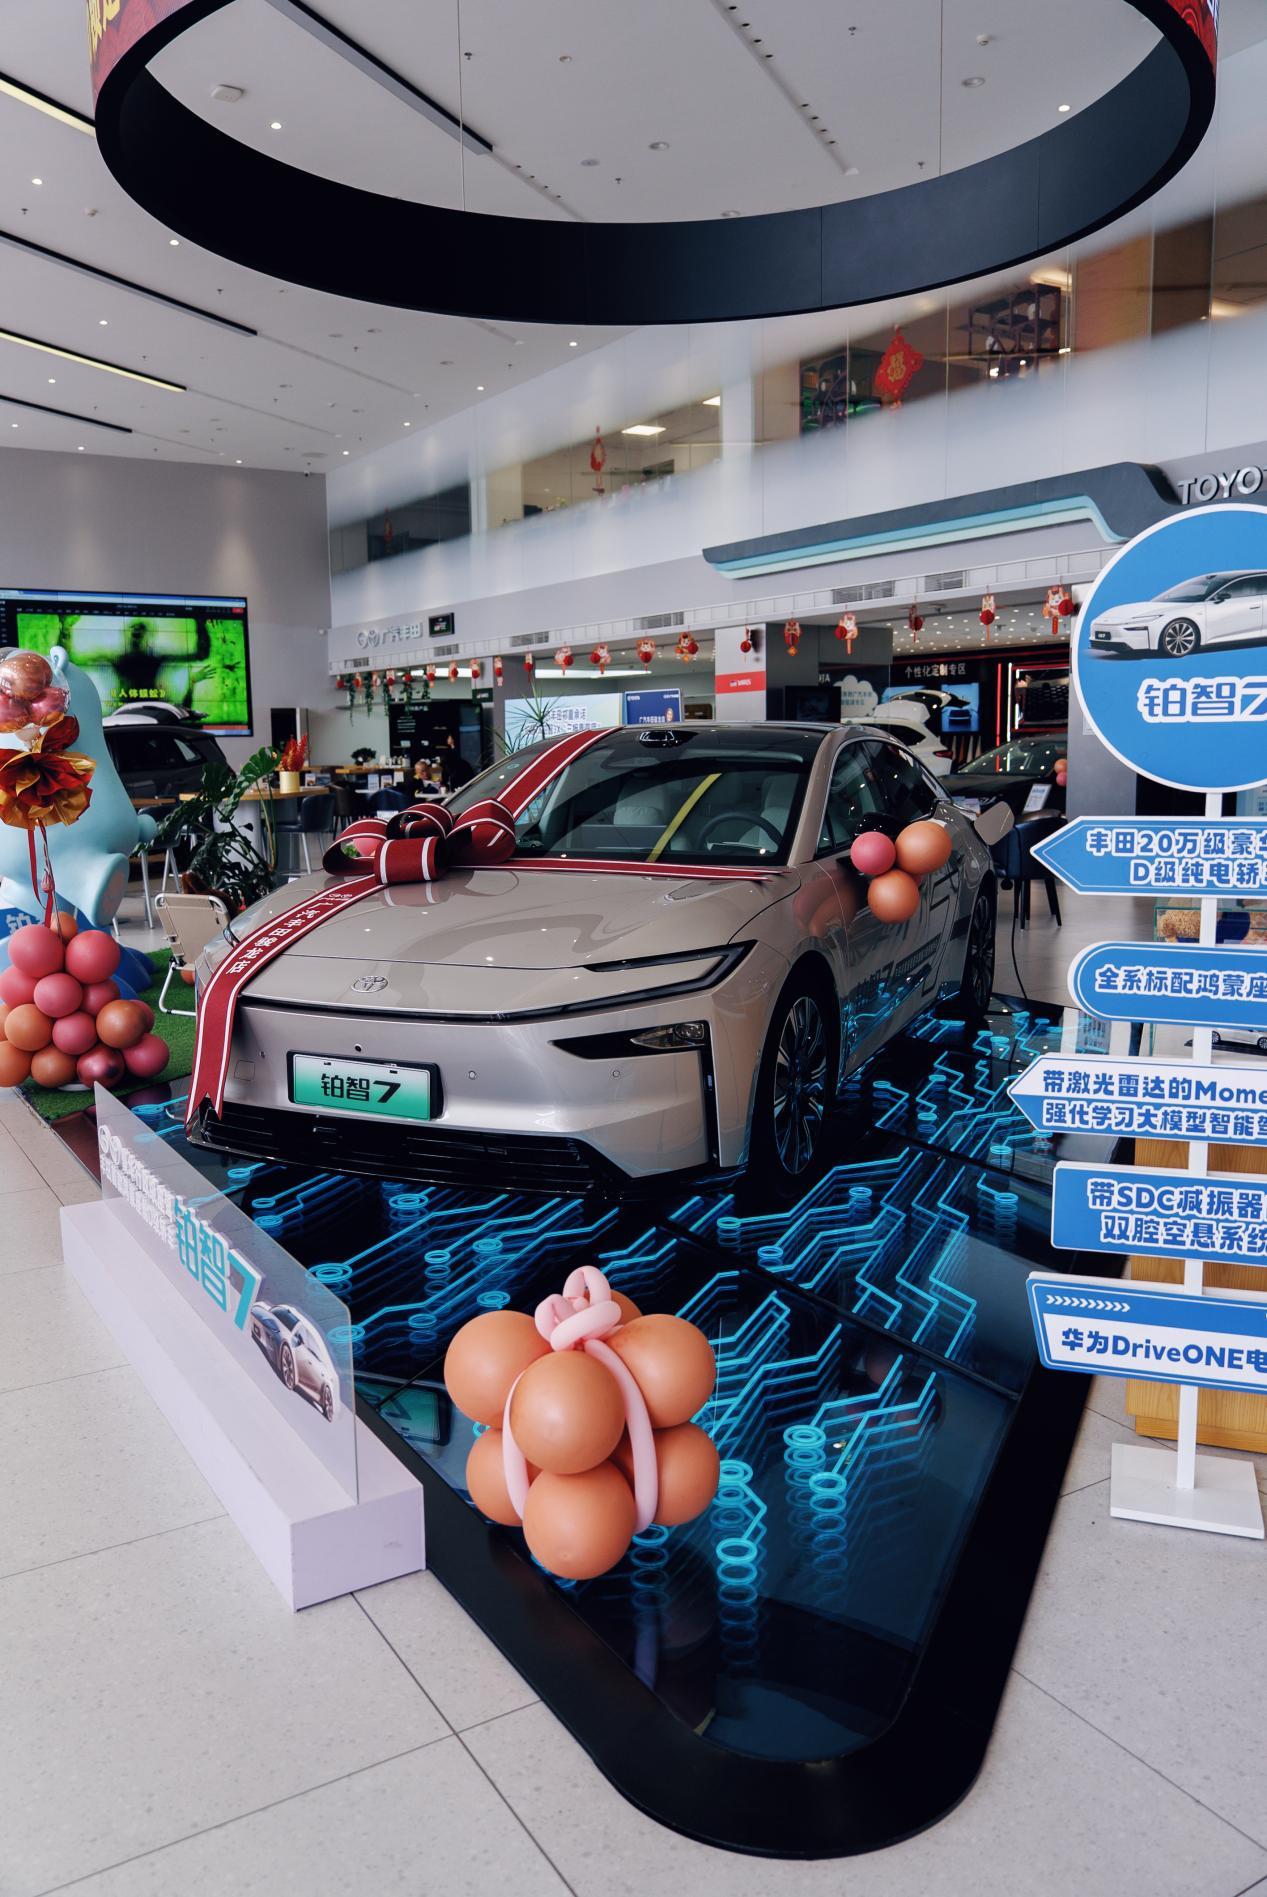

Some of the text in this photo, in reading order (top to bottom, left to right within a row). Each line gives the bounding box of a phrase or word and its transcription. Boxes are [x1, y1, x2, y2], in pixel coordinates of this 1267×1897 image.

[1178, 465, 1267, 504] TOYO
[905, 663, 966, 679] 个性化定制专区
[1132, 861, 1267, 885] D级纯电轿
[1097, 967, 1267, 999] 全系标配鸿蒙座
[321, 1073, 401, 1103] 铂智7
[1103, 1215, 1267, 1253] 双腔空悬系统
[173, 1195, 262, 1333] 铂智7
[1061, 1327, 1267, 1374] 华为DriveONE电
